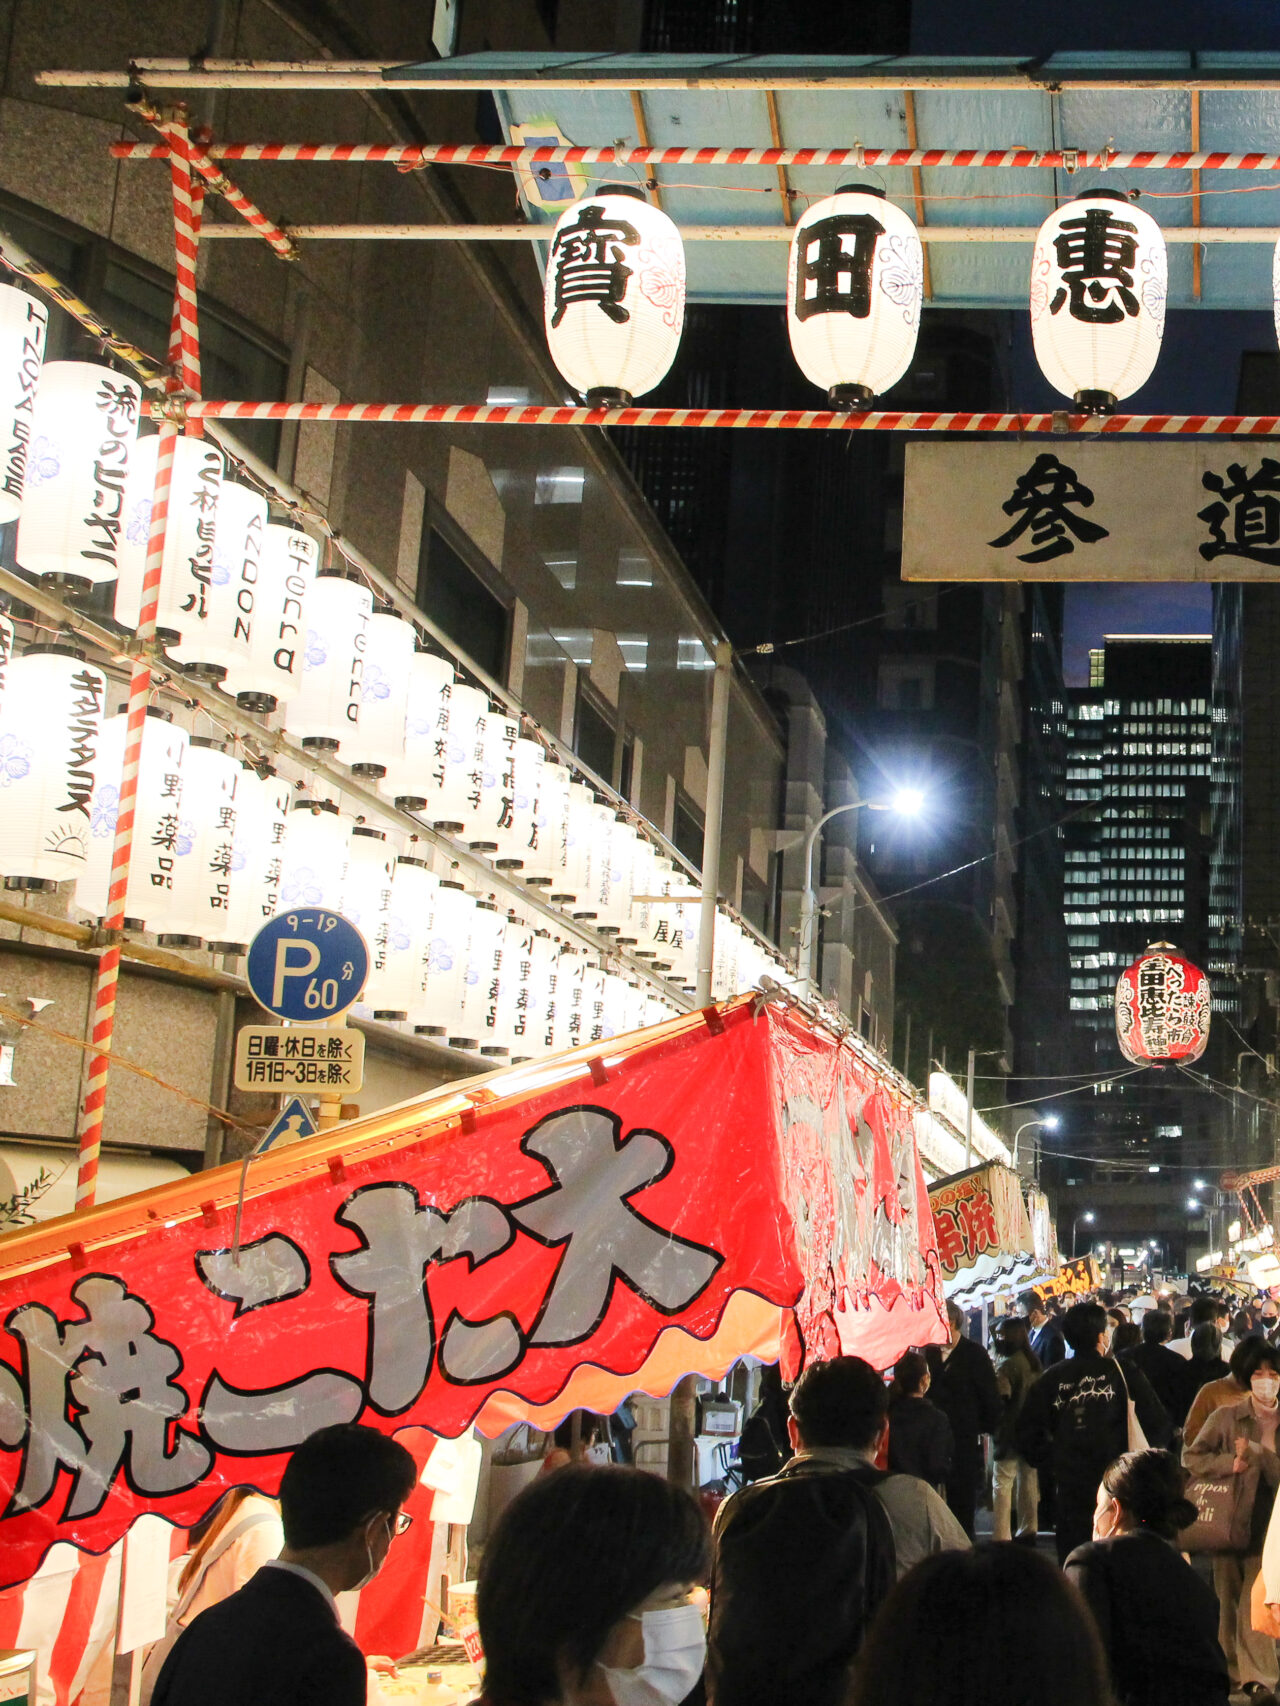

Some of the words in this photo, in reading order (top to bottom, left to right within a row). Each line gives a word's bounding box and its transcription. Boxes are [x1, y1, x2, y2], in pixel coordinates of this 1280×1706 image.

[796, 214, 885, 321] 田
[234, 514, 262, 642] ANDON
[287, 914, 337, 932] 9-19
[272, 938, 321, 1007] P
[304, 978, 338, 1009] 60
[341, 962, 354, 980] 分
[248, 1036, 353, 1059] 日曜・休日を除く
[0, 1104, 725, 1520] 大たこ焼
